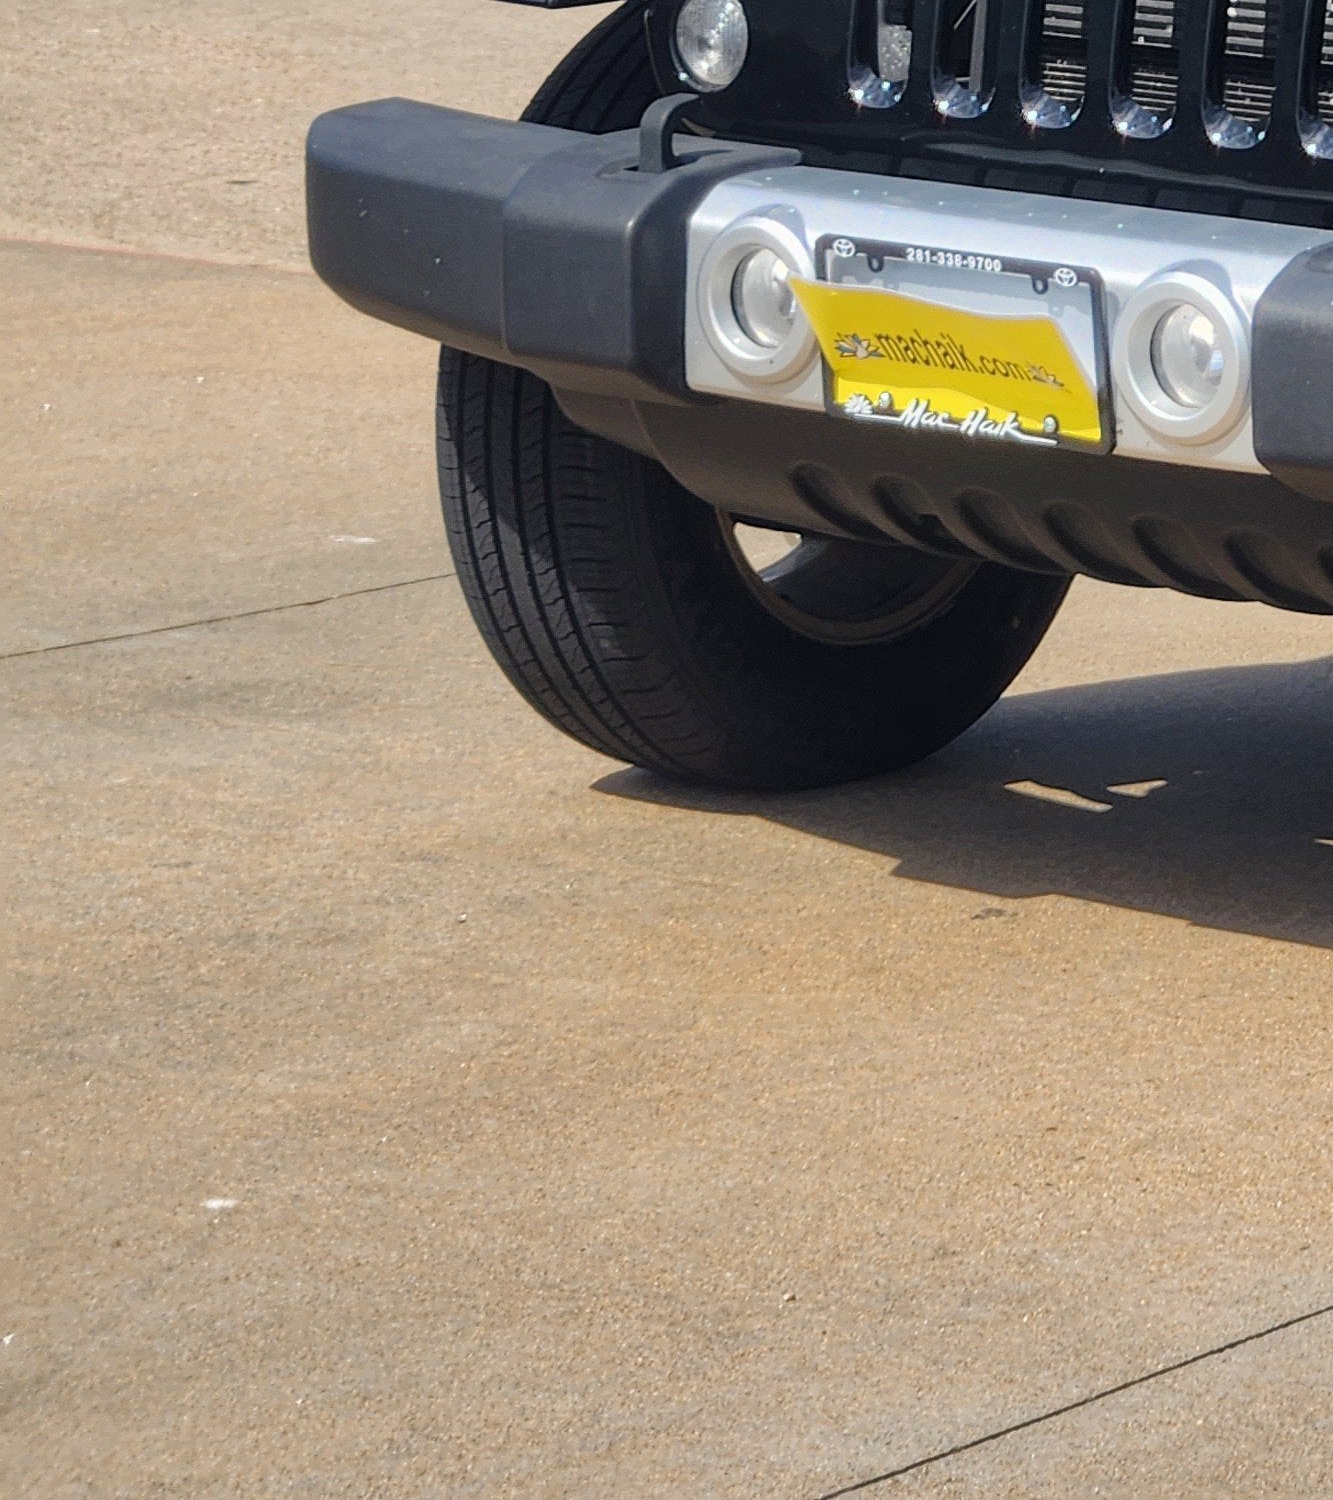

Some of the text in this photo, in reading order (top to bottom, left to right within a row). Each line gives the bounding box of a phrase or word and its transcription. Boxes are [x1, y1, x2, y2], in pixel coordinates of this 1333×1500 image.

[906, 248, 1002, 271] 281-338-9700
[875, 328, 1033, 382] machaik.com
[897, 398, 956, 428] Mac
